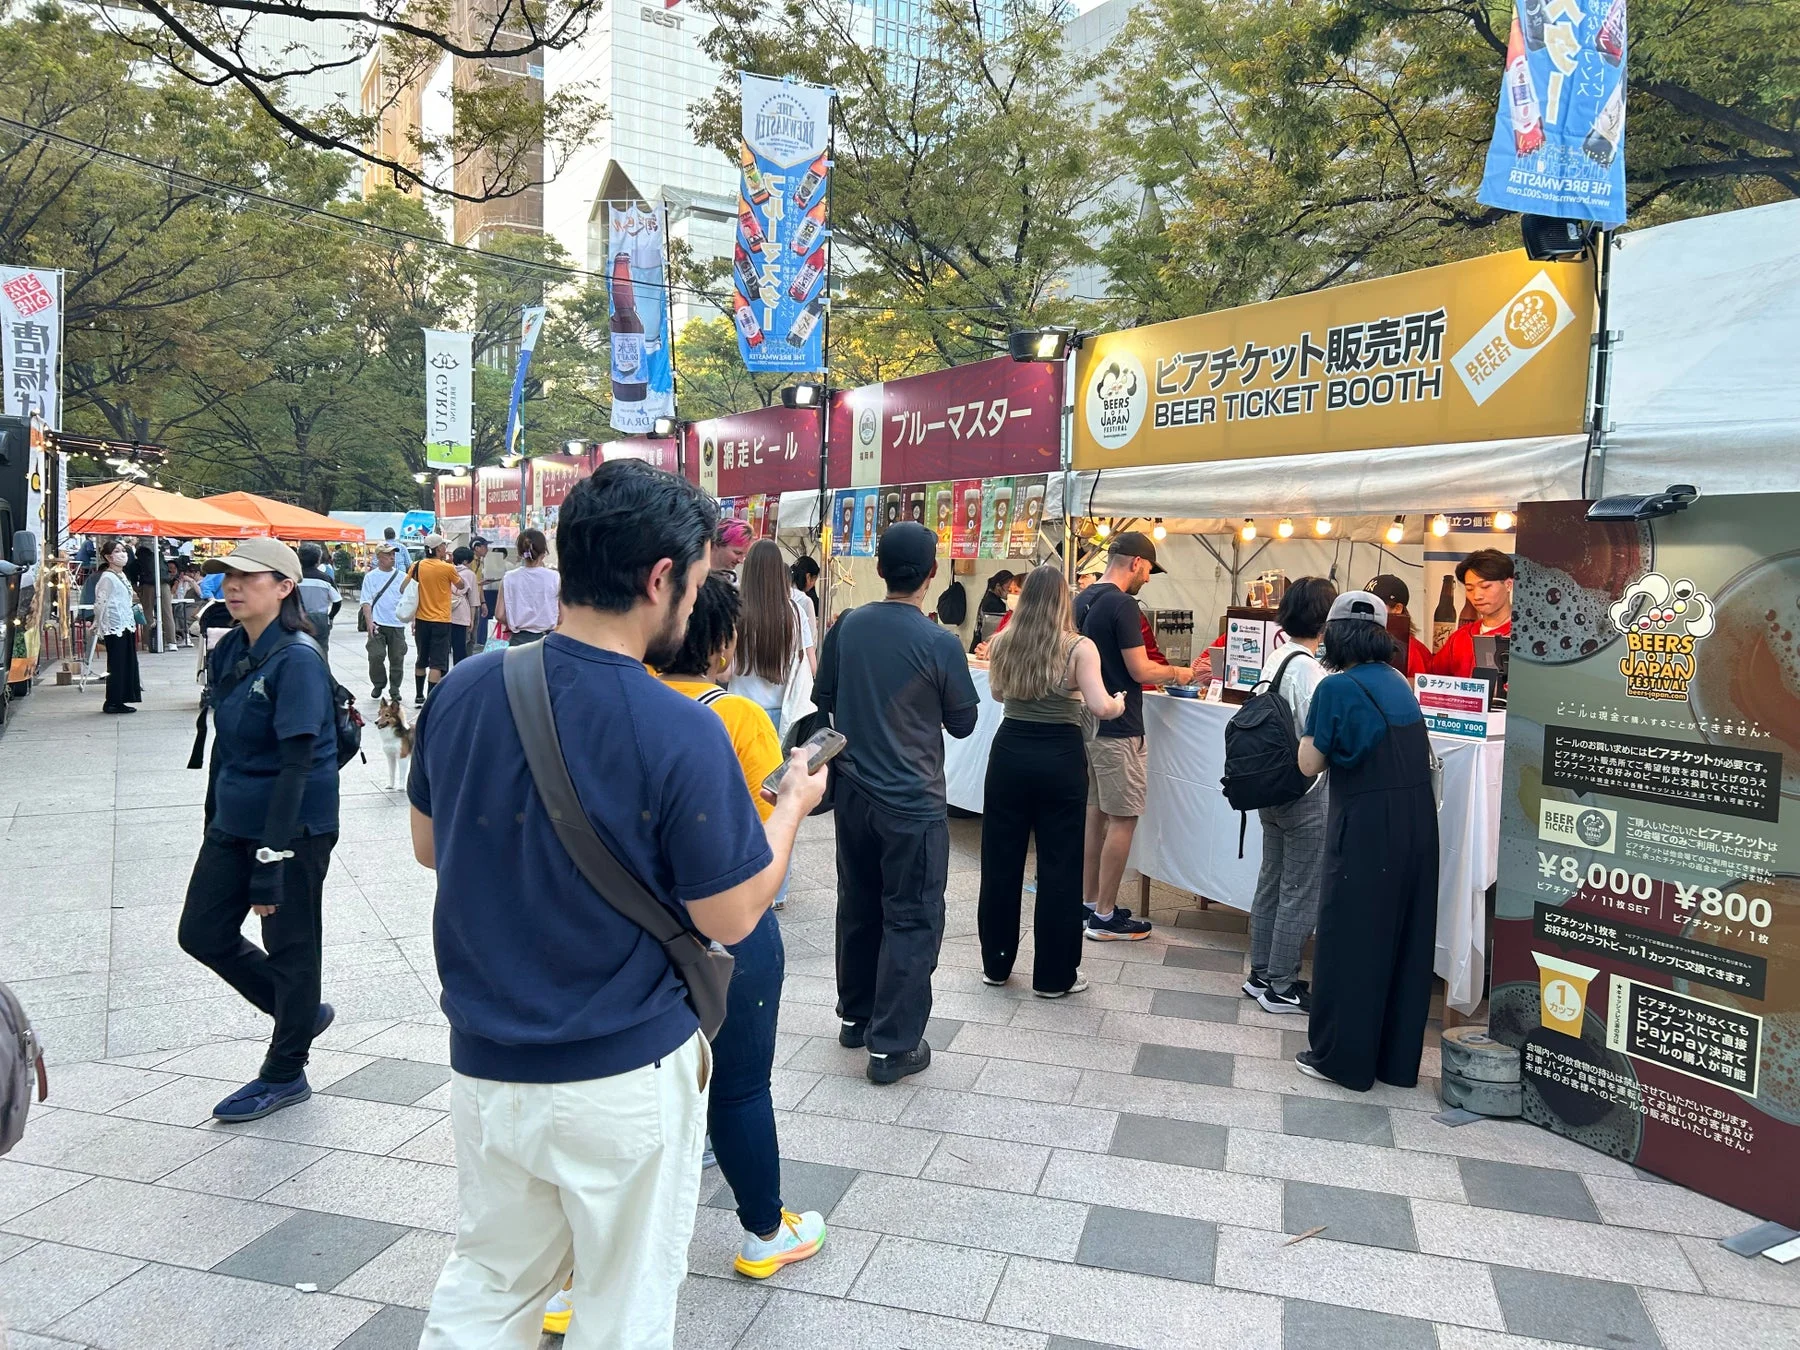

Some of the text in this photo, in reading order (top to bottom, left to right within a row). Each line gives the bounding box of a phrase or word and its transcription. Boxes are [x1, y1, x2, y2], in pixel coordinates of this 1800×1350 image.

[641, 7, 684, 29] BEST
[1156, 307, 1446, 394] ビアチケット販売所
[1464, 336, 1509, 378] BEER
[1472, 346, 1511, 386] TICKET
[1104, 397, 1129, 410] BEERS
[1155, 369, 1442, 428] BEER TICKET BOOTH
[892, 398, 1032, 448] ブルーマスター
[1101, 409, 1129, 426] JAPAN
[1104, 425, 1127, 433] FESTIVAL
[723, 432, 798, 470] 網走ビール
[1628, 634, 1695, 655] BEERS
[1620, 651, 1695, 680] JAPAN
[1430, 680, 1485, 693] チケット販売所
[1629, 677, 1687, 691] FESTIVAL
[1437, 719, 1461, 729] ¥8,000
[1464, 723, 1483, 732] ¥800
[1545, 811, 1574, 826] BEER
[1545, 822, 1574, 834] TICKET
[1538, 852, 1652, 900] ¥8,000
[1537, 881, 1587, 900] ビアチケット
[1628, 903, 1650, 915] SET
[1674, 880, 1772, 928] ¥800
[1545, 912, 1617, 939] ビアチケット1枚を
[1673, 913, 1733, 937] ビアチケット
[1556, 985, 1566, 1005] 1
[1550, 1002, 1576, 1017] カップ
[1638, 995, 1749, 1036] ビアチケットがなくても
[1637, 1008, 1747, 1051] ビアブースにて直接
[1636, 1036, 1746, 1082] ビールの購入が可能
